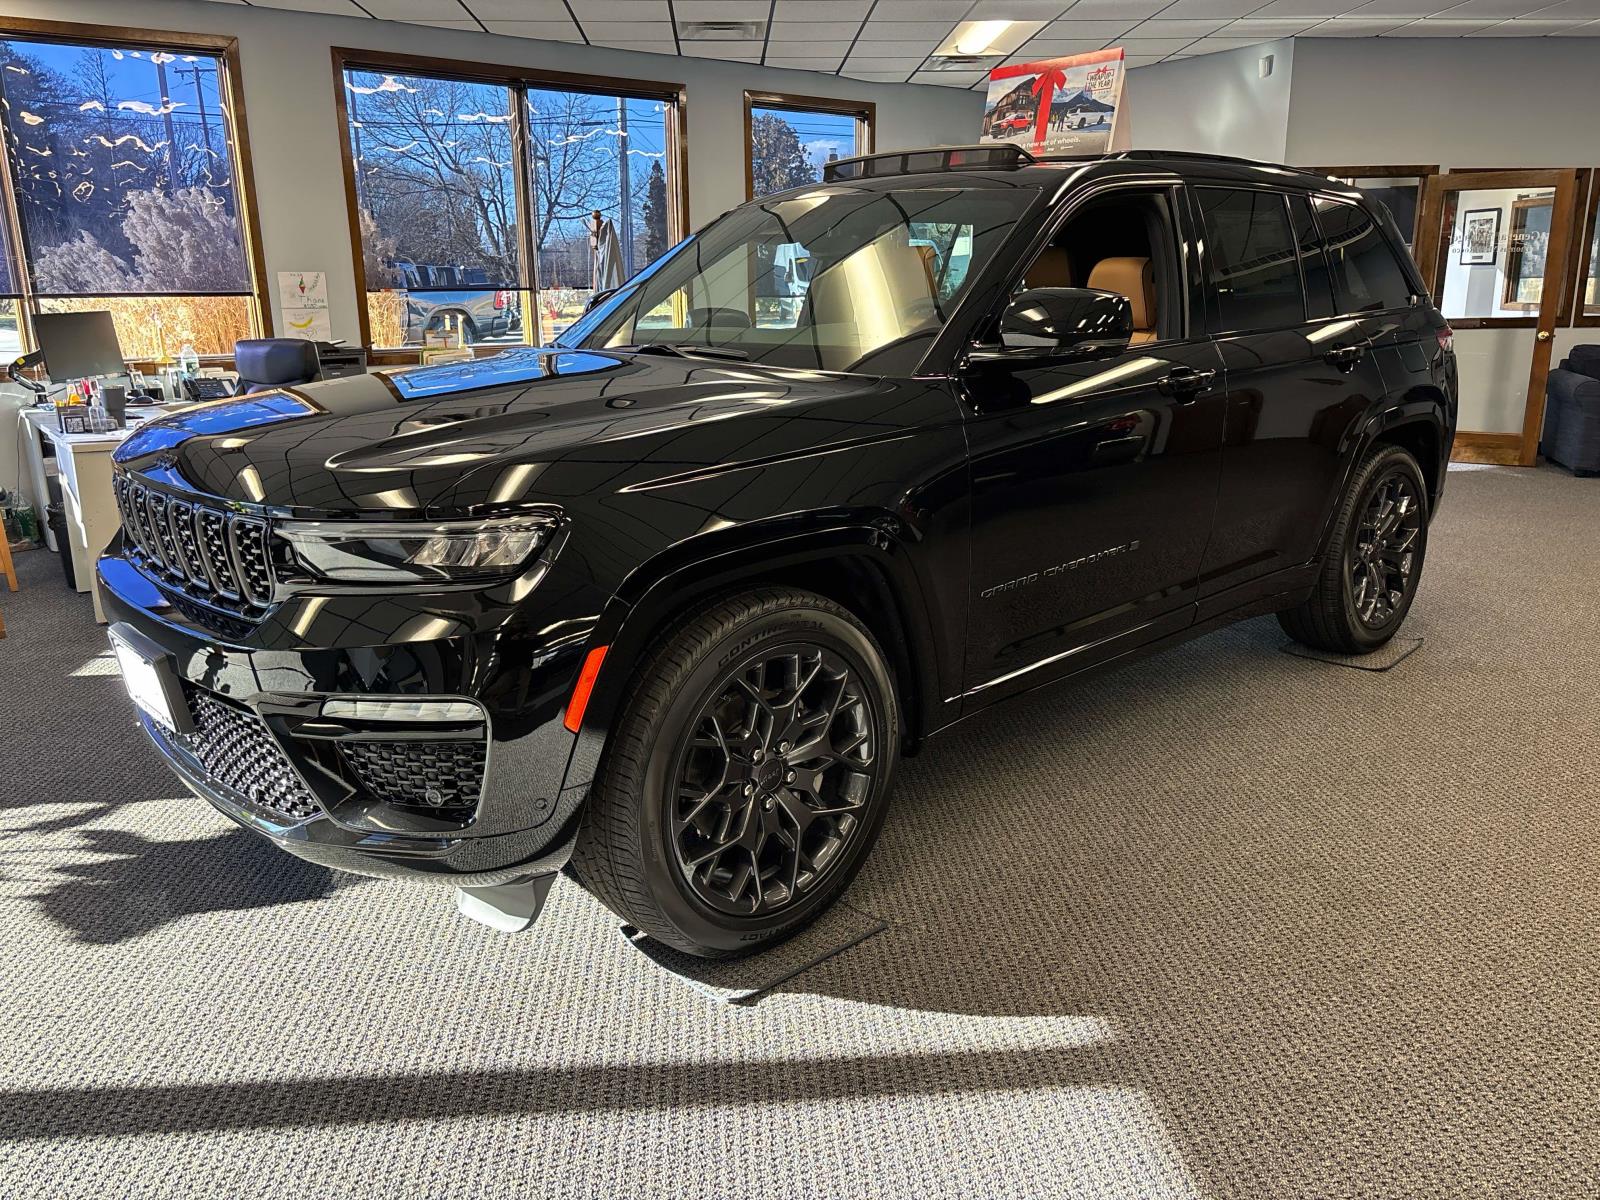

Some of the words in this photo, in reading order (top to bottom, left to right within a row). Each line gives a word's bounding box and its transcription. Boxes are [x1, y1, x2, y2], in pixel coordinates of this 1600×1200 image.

[1097, 79, 1111, 88] YEAR
[980, 572, 1039, 599] GRAND
[1042, 544, 1127, 577] CHEROKEE
